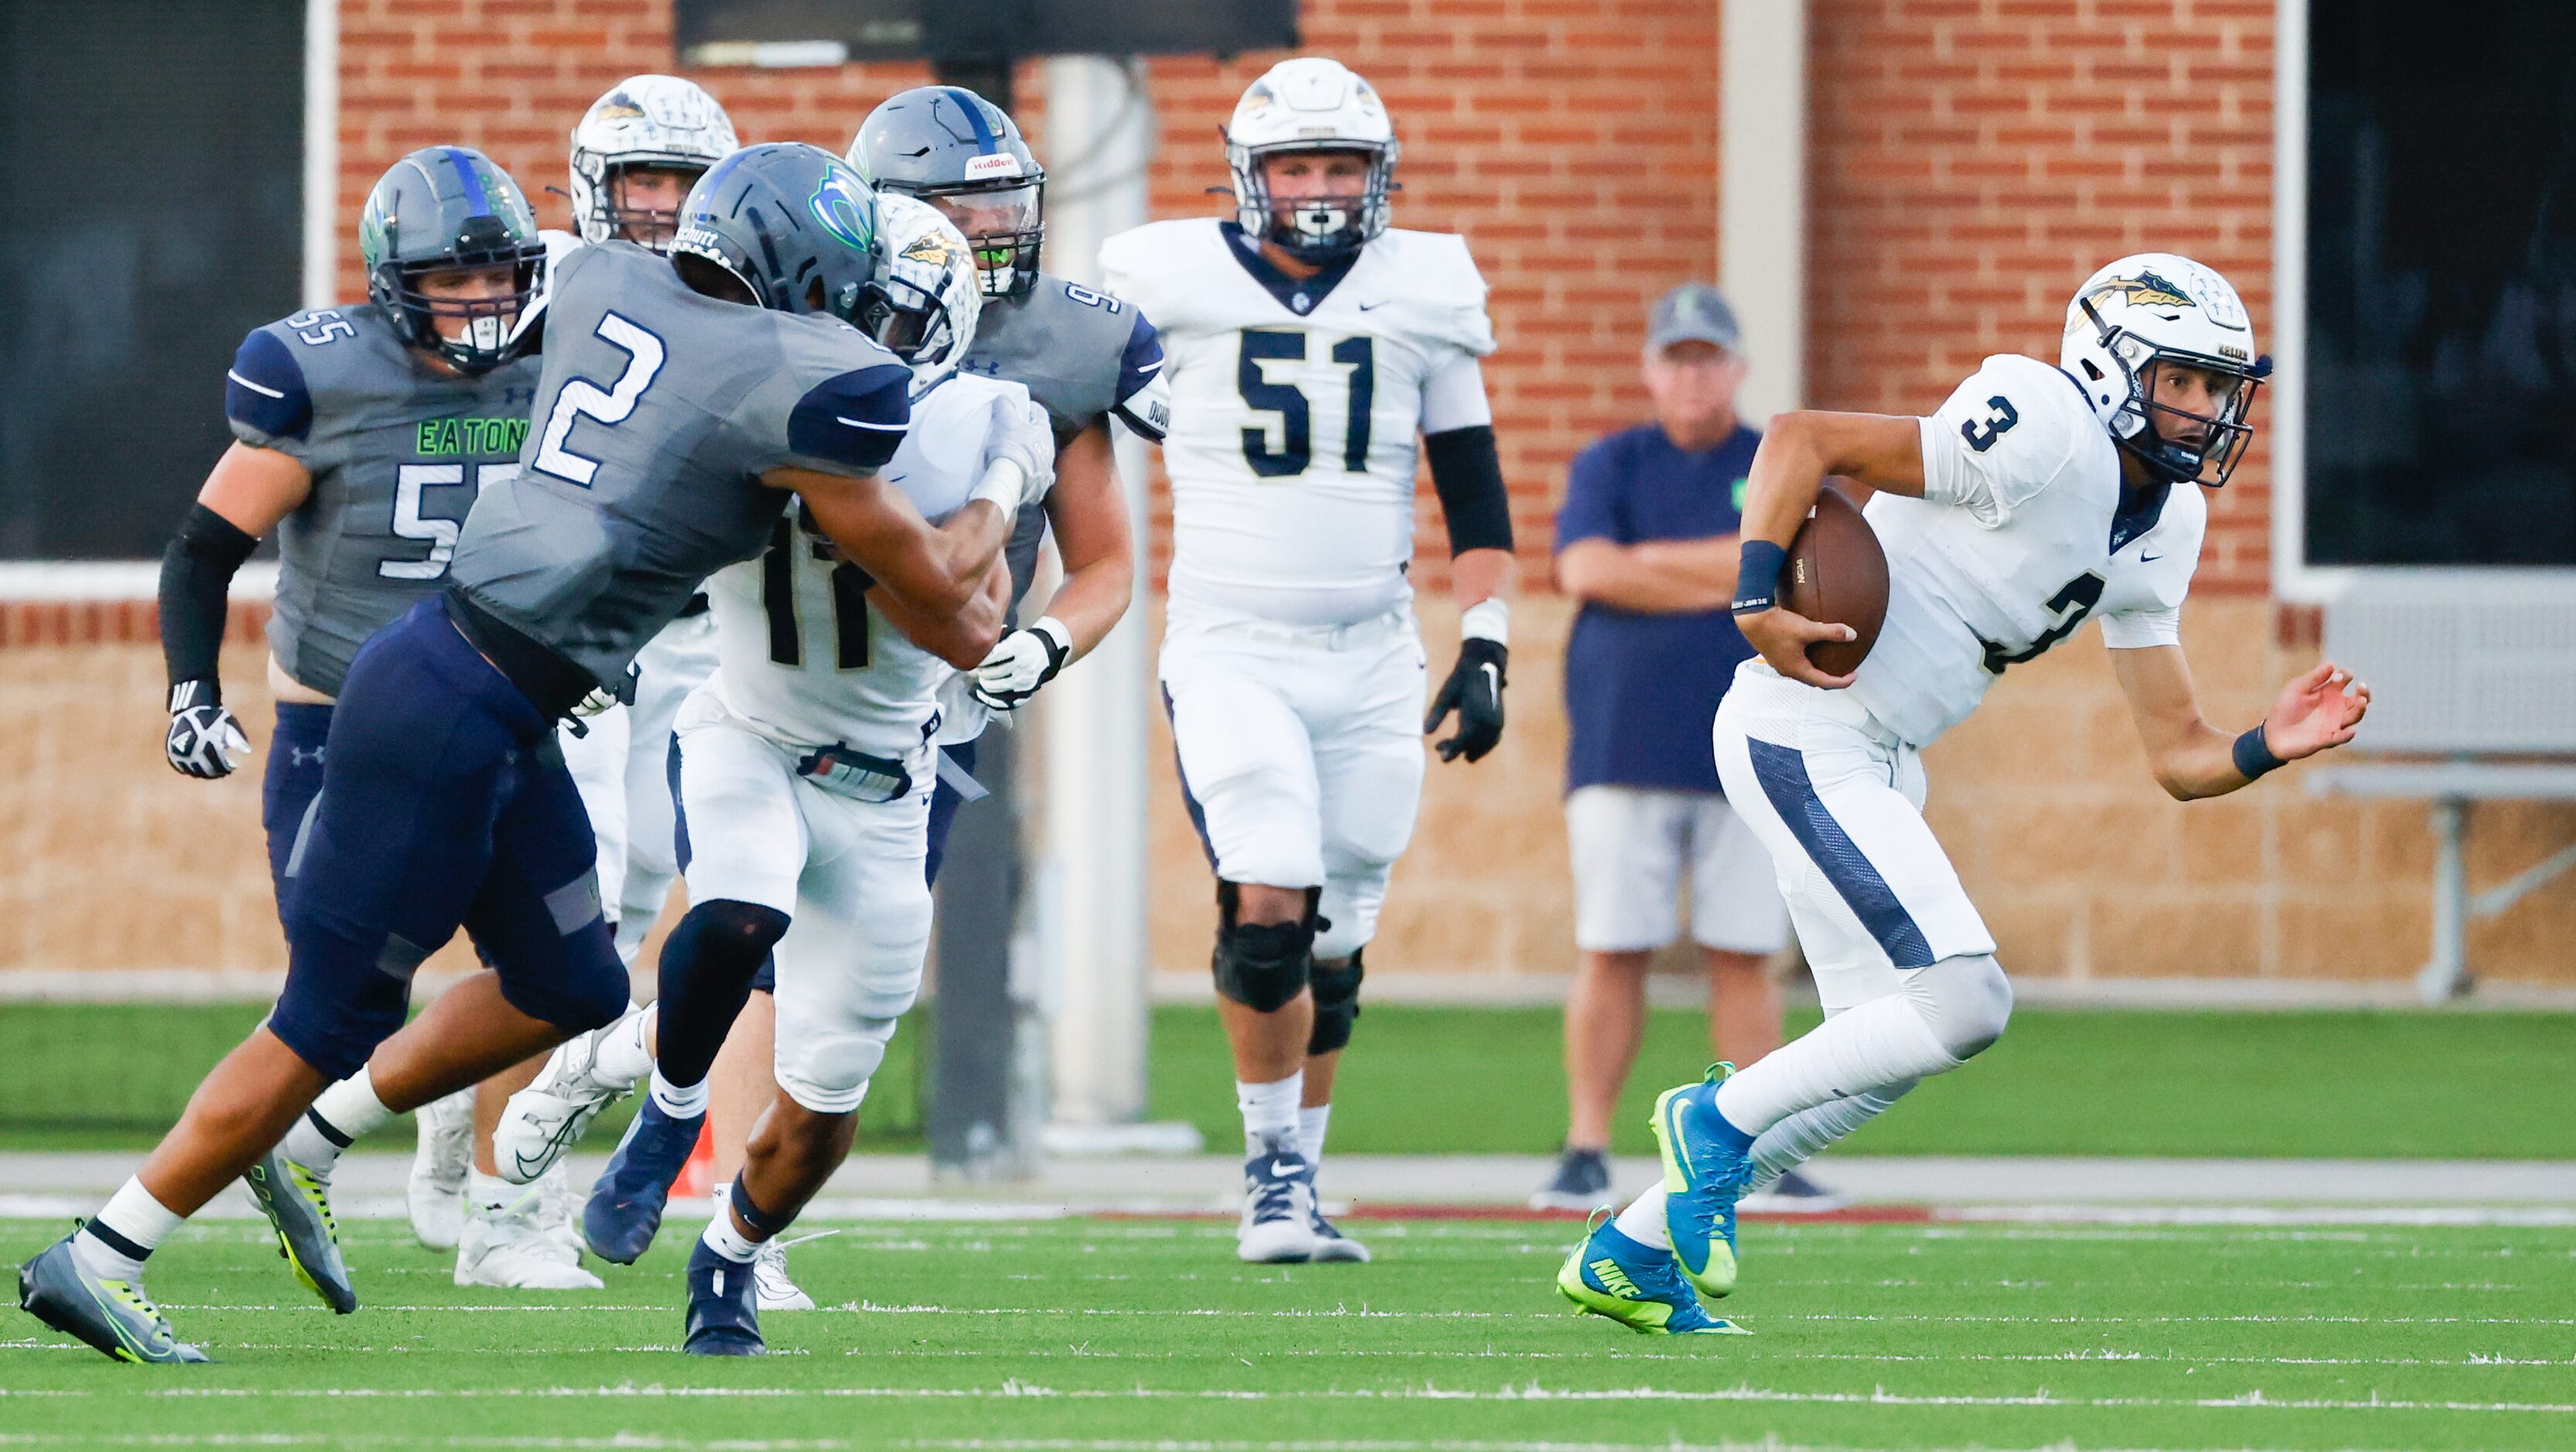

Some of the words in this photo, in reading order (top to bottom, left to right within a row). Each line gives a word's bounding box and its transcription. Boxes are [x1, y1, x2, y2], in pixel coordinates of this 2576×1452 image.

[1065, 281, 1121, 315] 9
[285, 309, 356, 346] 55
[531, 309, 667, 489] 2
[1237, 328, 1375, 479] 51
[416, 418, 532, 455] EATON
[1960, 394, 2019, 455] 3
[378, 463, 523, 580] 5
[1796, 558, 1806, 584] NCAA
[1589, 1257, 1641, 1300] NIKE
